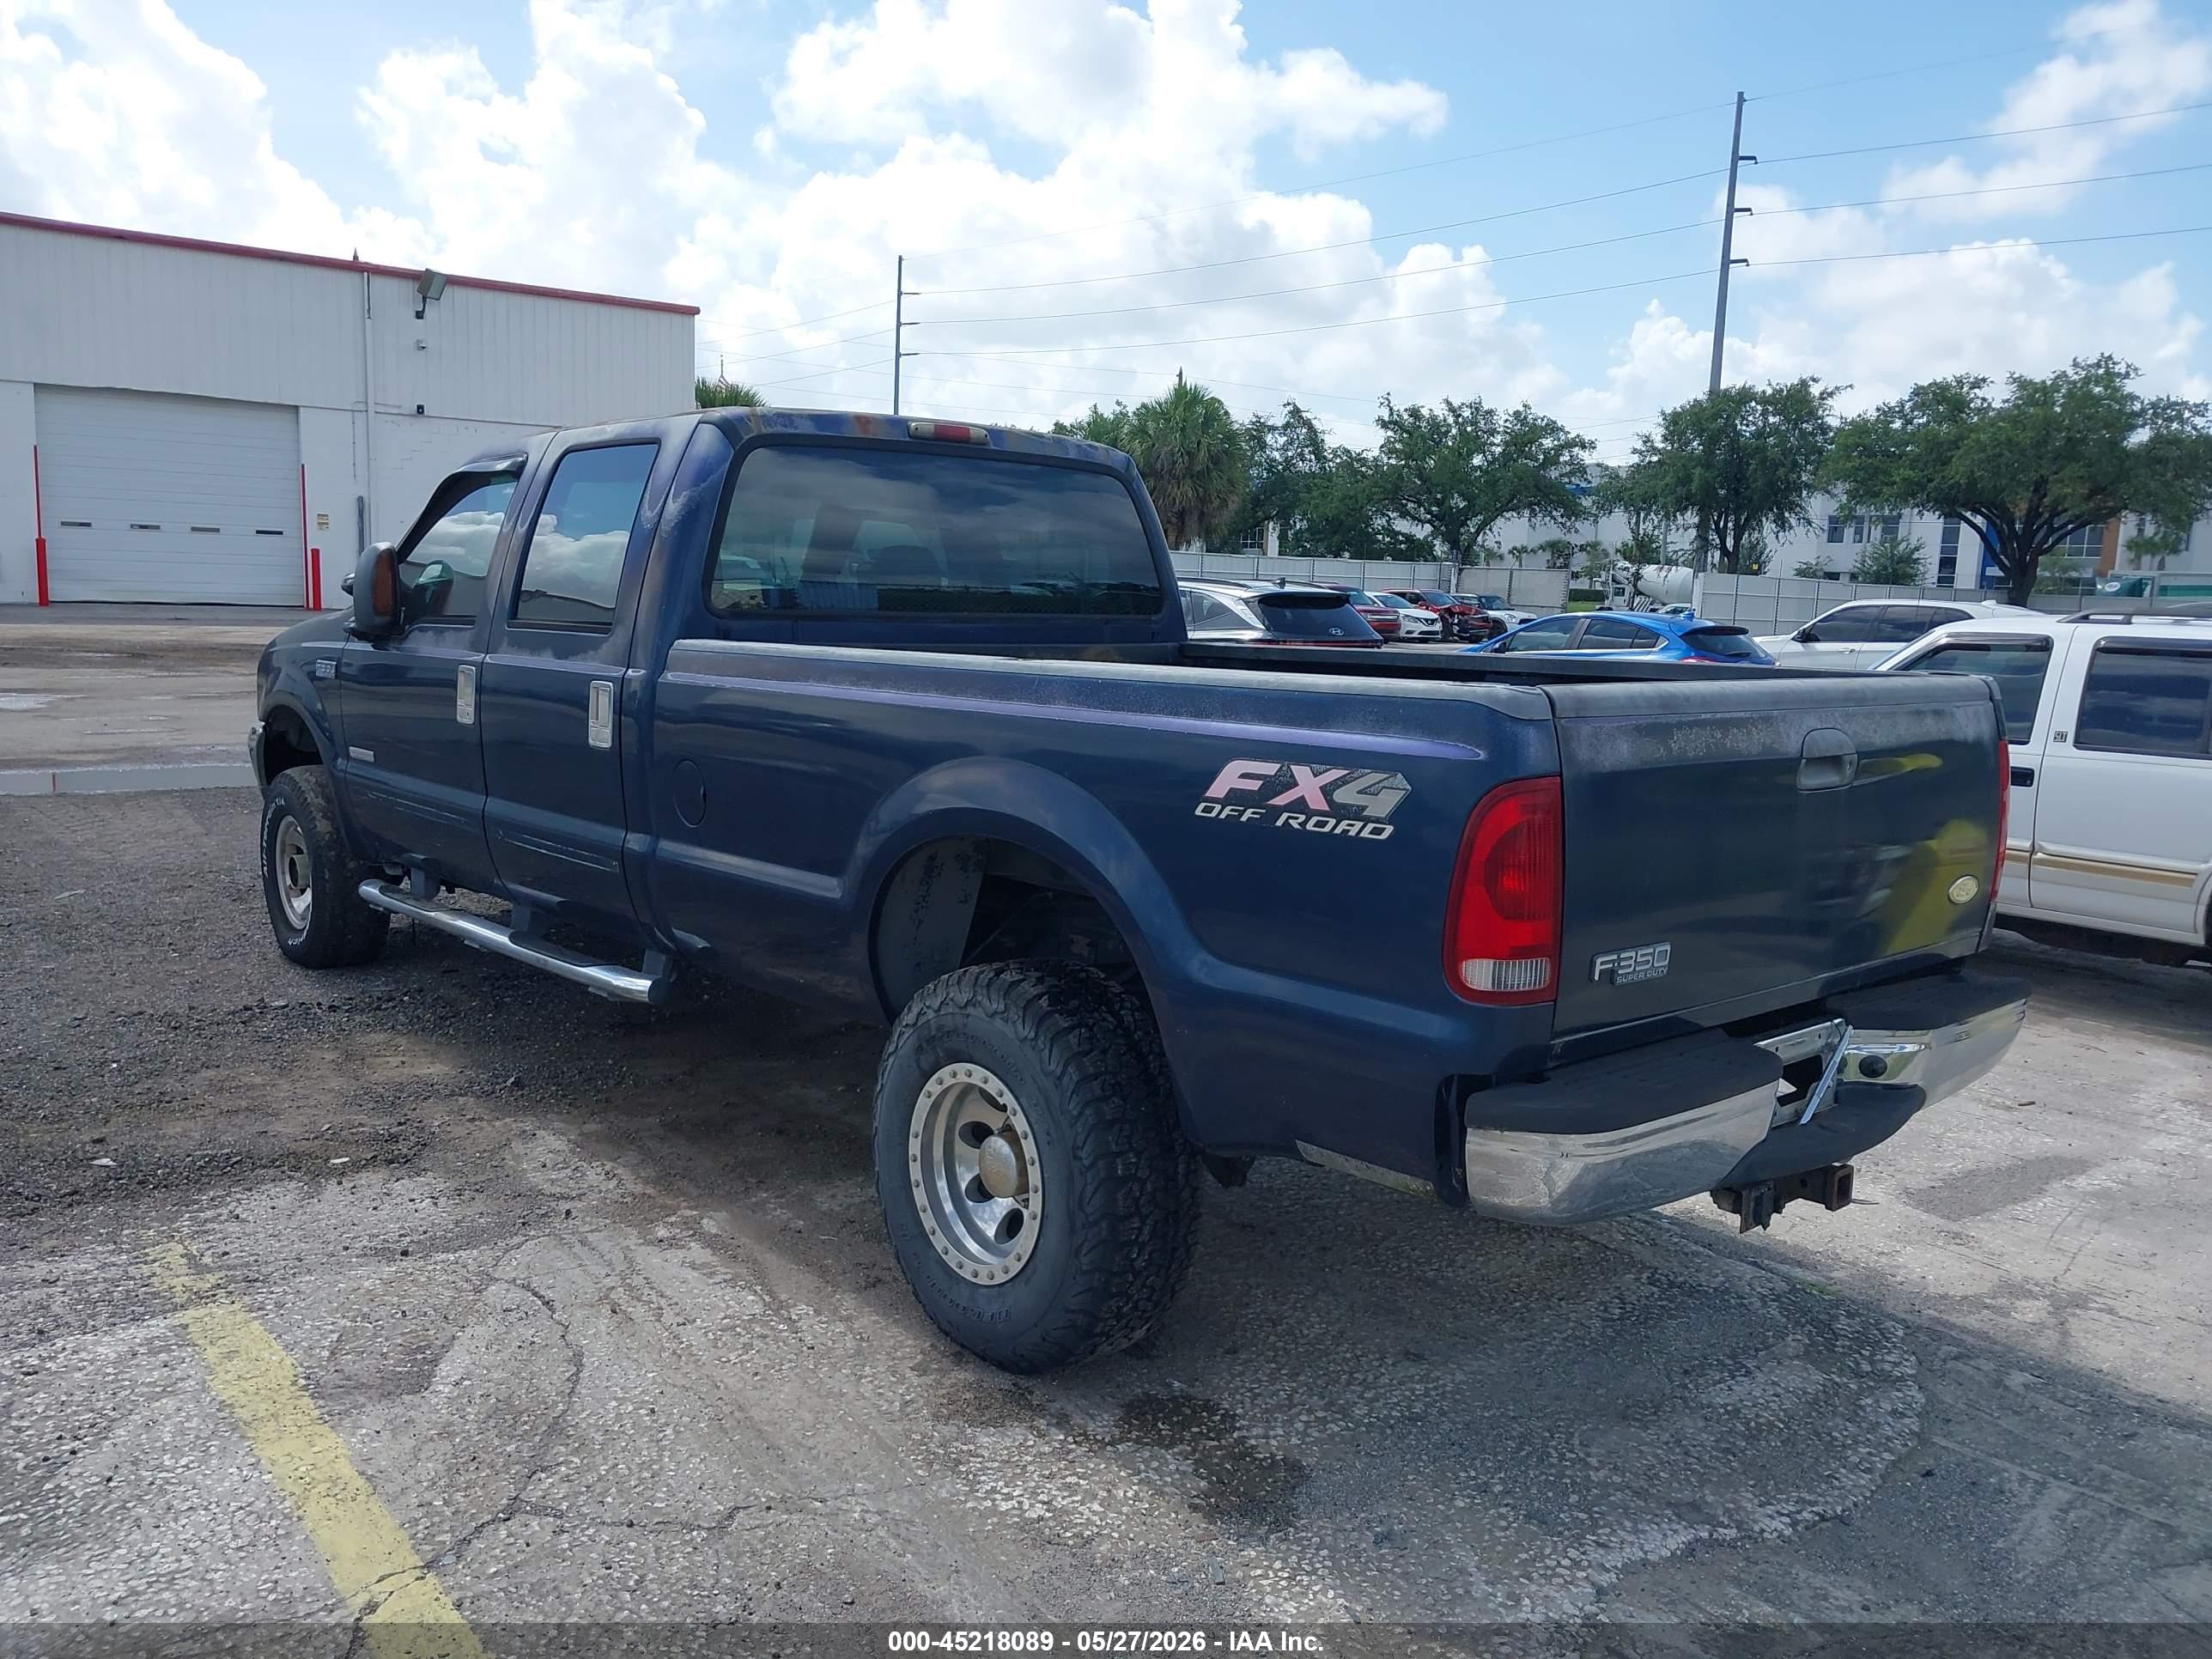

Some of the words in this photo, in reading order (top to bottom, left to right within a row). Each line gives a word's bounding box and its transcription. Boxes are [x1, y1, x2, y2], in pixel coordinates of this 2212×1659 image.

[1204, 759, 1412, 817] FX4
[1194, 802, 1266, 822] OFF
[1275, 812, 1395, 840] ROAD
[1617, 972, 1644, 983] SUPER
[1646, 967, 1668, 978] DUTY
